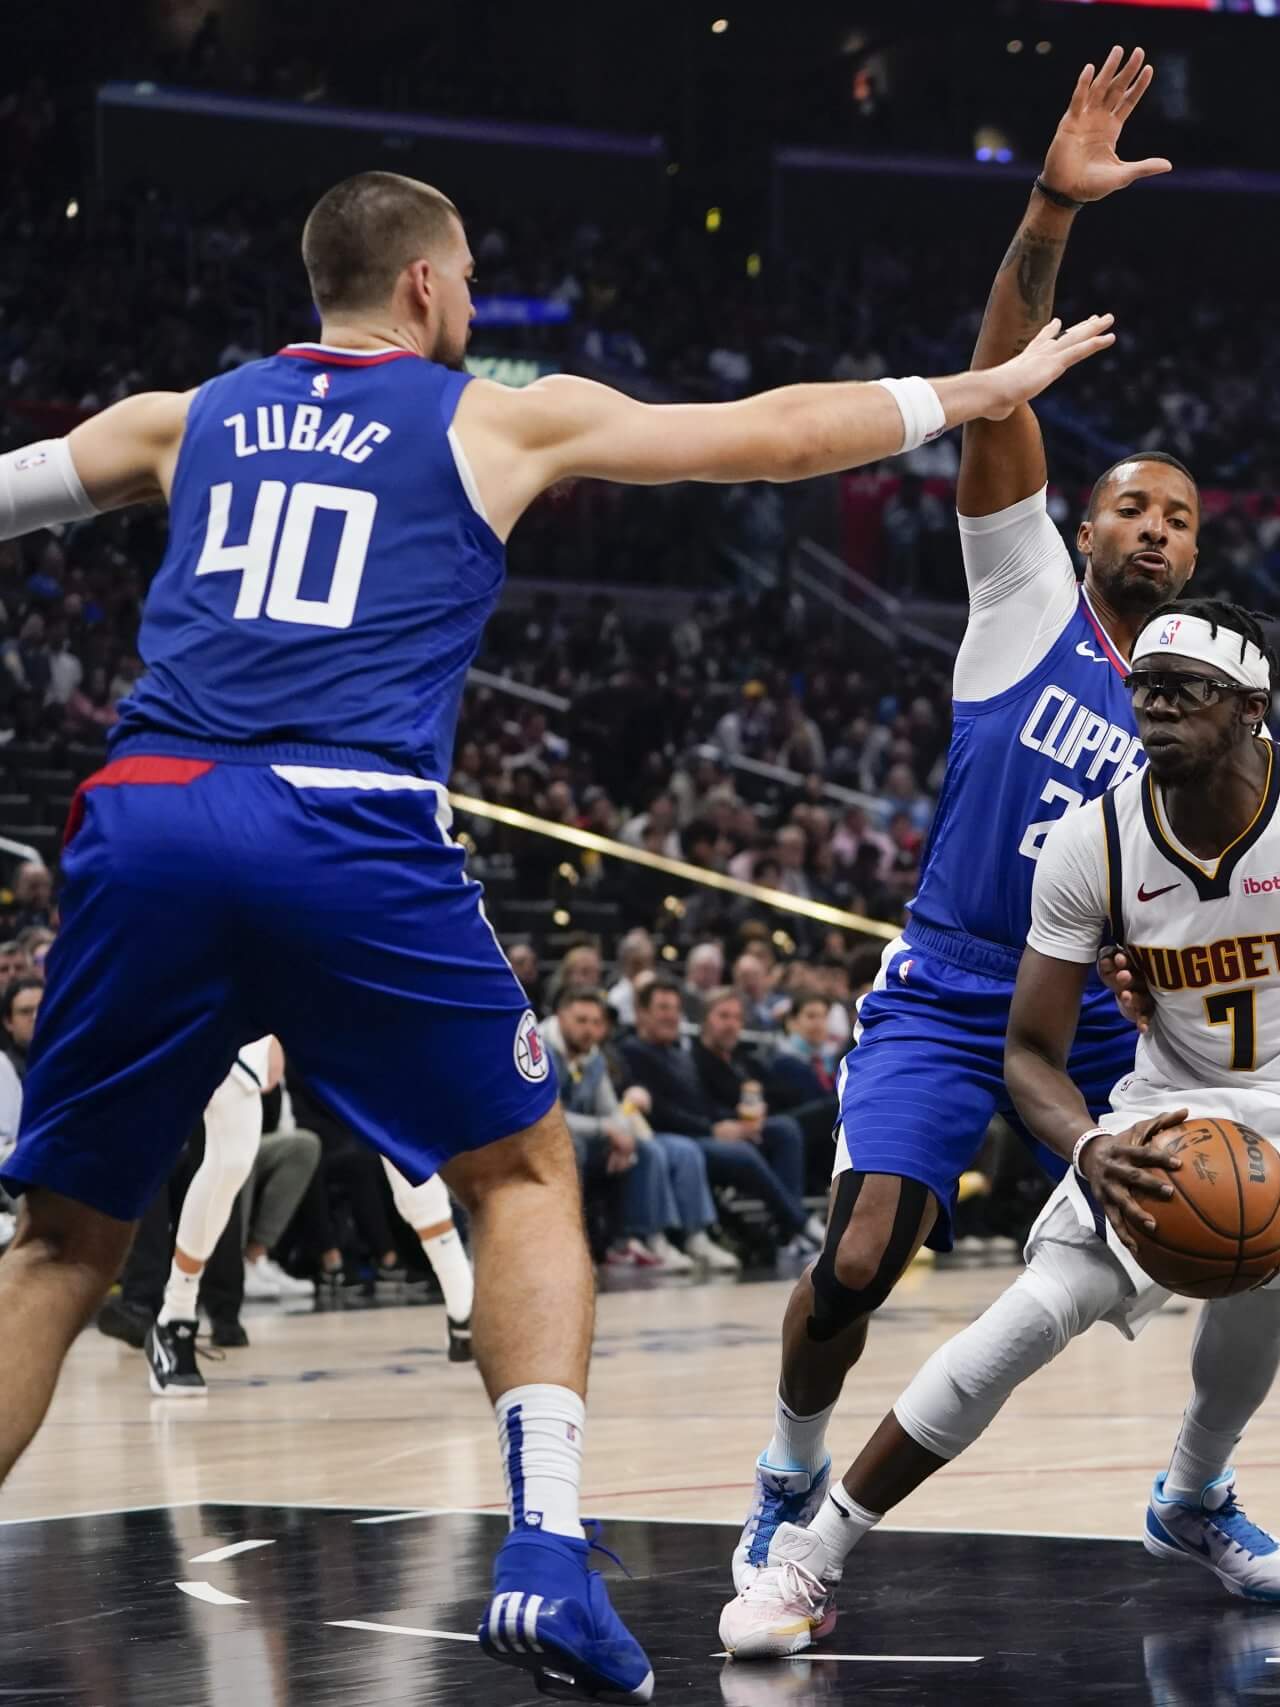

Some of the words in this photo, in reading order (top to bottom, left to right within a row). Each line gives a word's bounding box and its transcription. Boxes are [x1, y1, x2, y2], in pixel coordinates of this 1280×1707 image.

[223, 403, 391, 463] ZUBAC
[195, 480, 378, 629] 40
[1020, 685, 1148, 790] CLIPPE
[1018, 778, 1093, 860] 2
[1202, 986, 1257, 1072] 7
